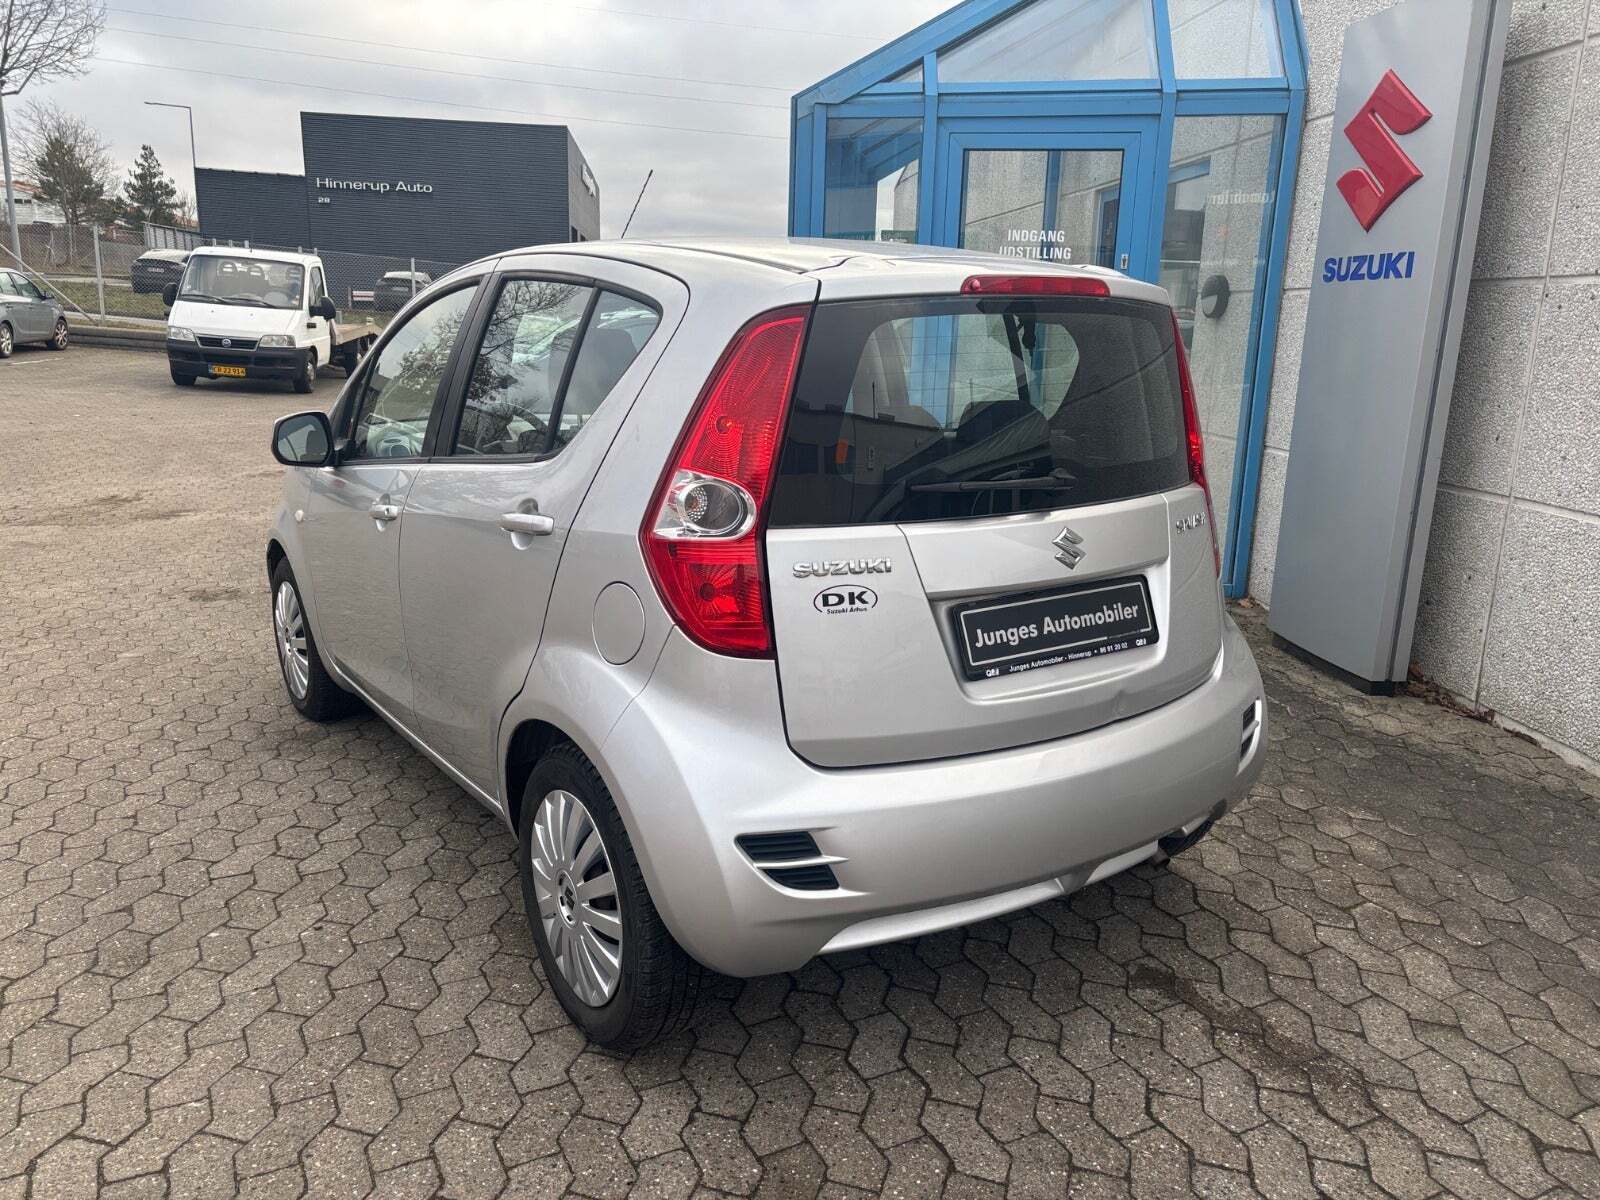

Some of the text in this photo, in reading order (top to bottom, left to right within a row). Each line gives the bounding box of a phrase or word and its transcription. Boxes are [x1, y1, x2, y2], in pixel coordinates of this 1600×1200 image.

[316, 177, 433, 194] Hinnerup Auto
[1007, 229, 1065, 242] INDGANG
[999, 245, 1072, 260] UDSTILLING
[1322, 251, 1415, 283] SUZUKI
[792, 558, 892, 578] SUZUKI
[821, 590, 869, 607] DK
[975, 603, 1138, 648] Junges Automobiler
[1009, 663, 1029, 672] Junges
[1030, 656, 1064, 668] Automobiler
[1068, 651, 1092, 660] Hinnerup
